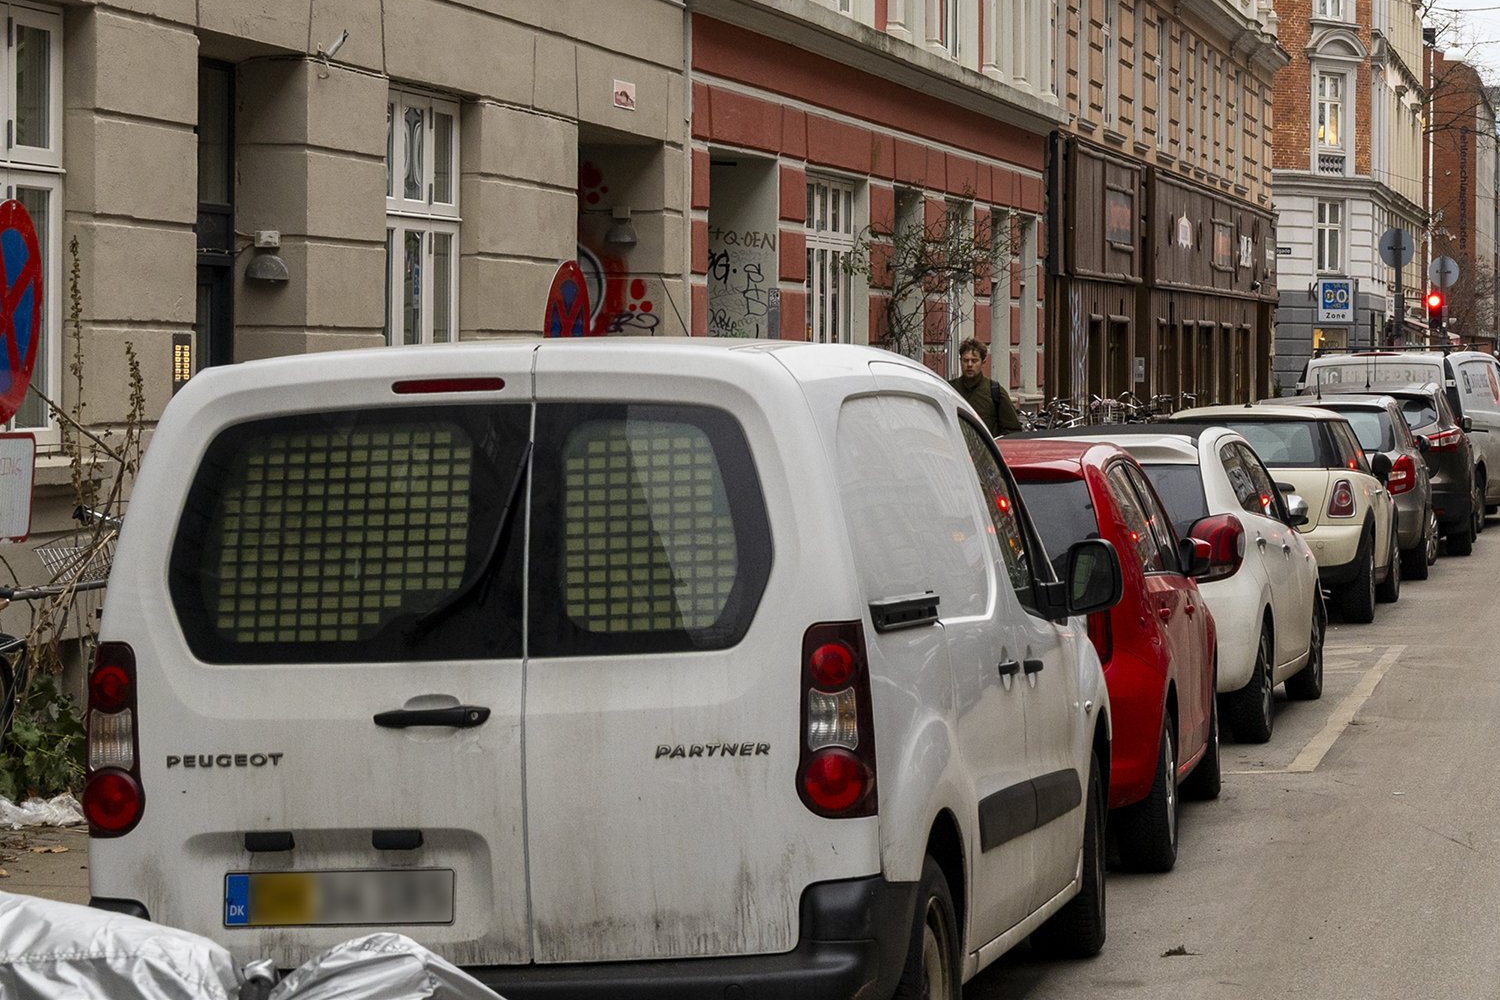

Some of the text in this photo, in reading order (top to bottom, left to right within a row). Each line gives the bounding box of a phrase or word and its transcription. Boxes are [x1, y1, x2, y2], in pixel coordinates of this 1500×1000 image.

[655, 741, 772, 759] PARTNER
[166, 752, 283, 768] PEUGEOT
[230, 904, 245, 917] DK
